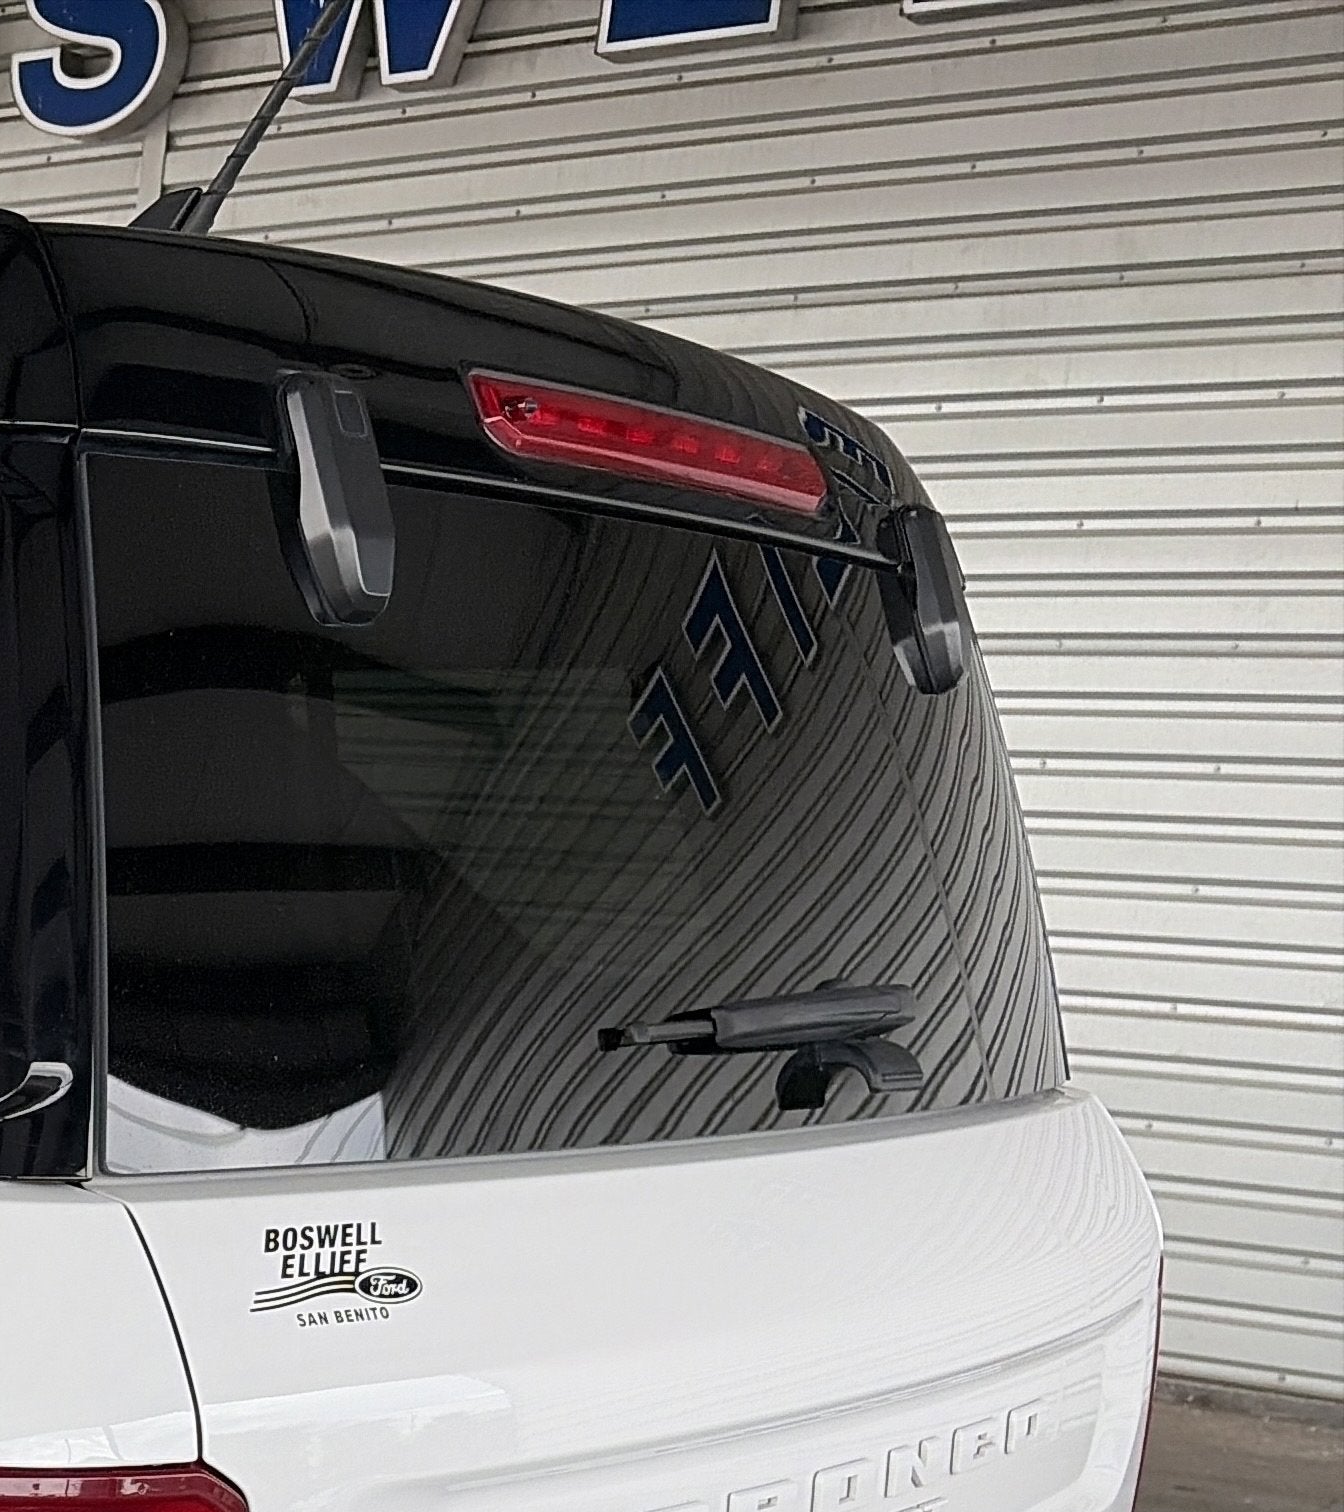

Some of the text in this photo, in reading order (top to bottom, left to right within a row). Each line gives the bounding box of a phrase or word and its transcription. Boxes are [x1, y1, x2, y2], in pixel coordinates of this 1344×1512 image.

[264, 1222, 382, 1253] BOSWELL
[296, 1306, 390, 1327] SAN BENITO
